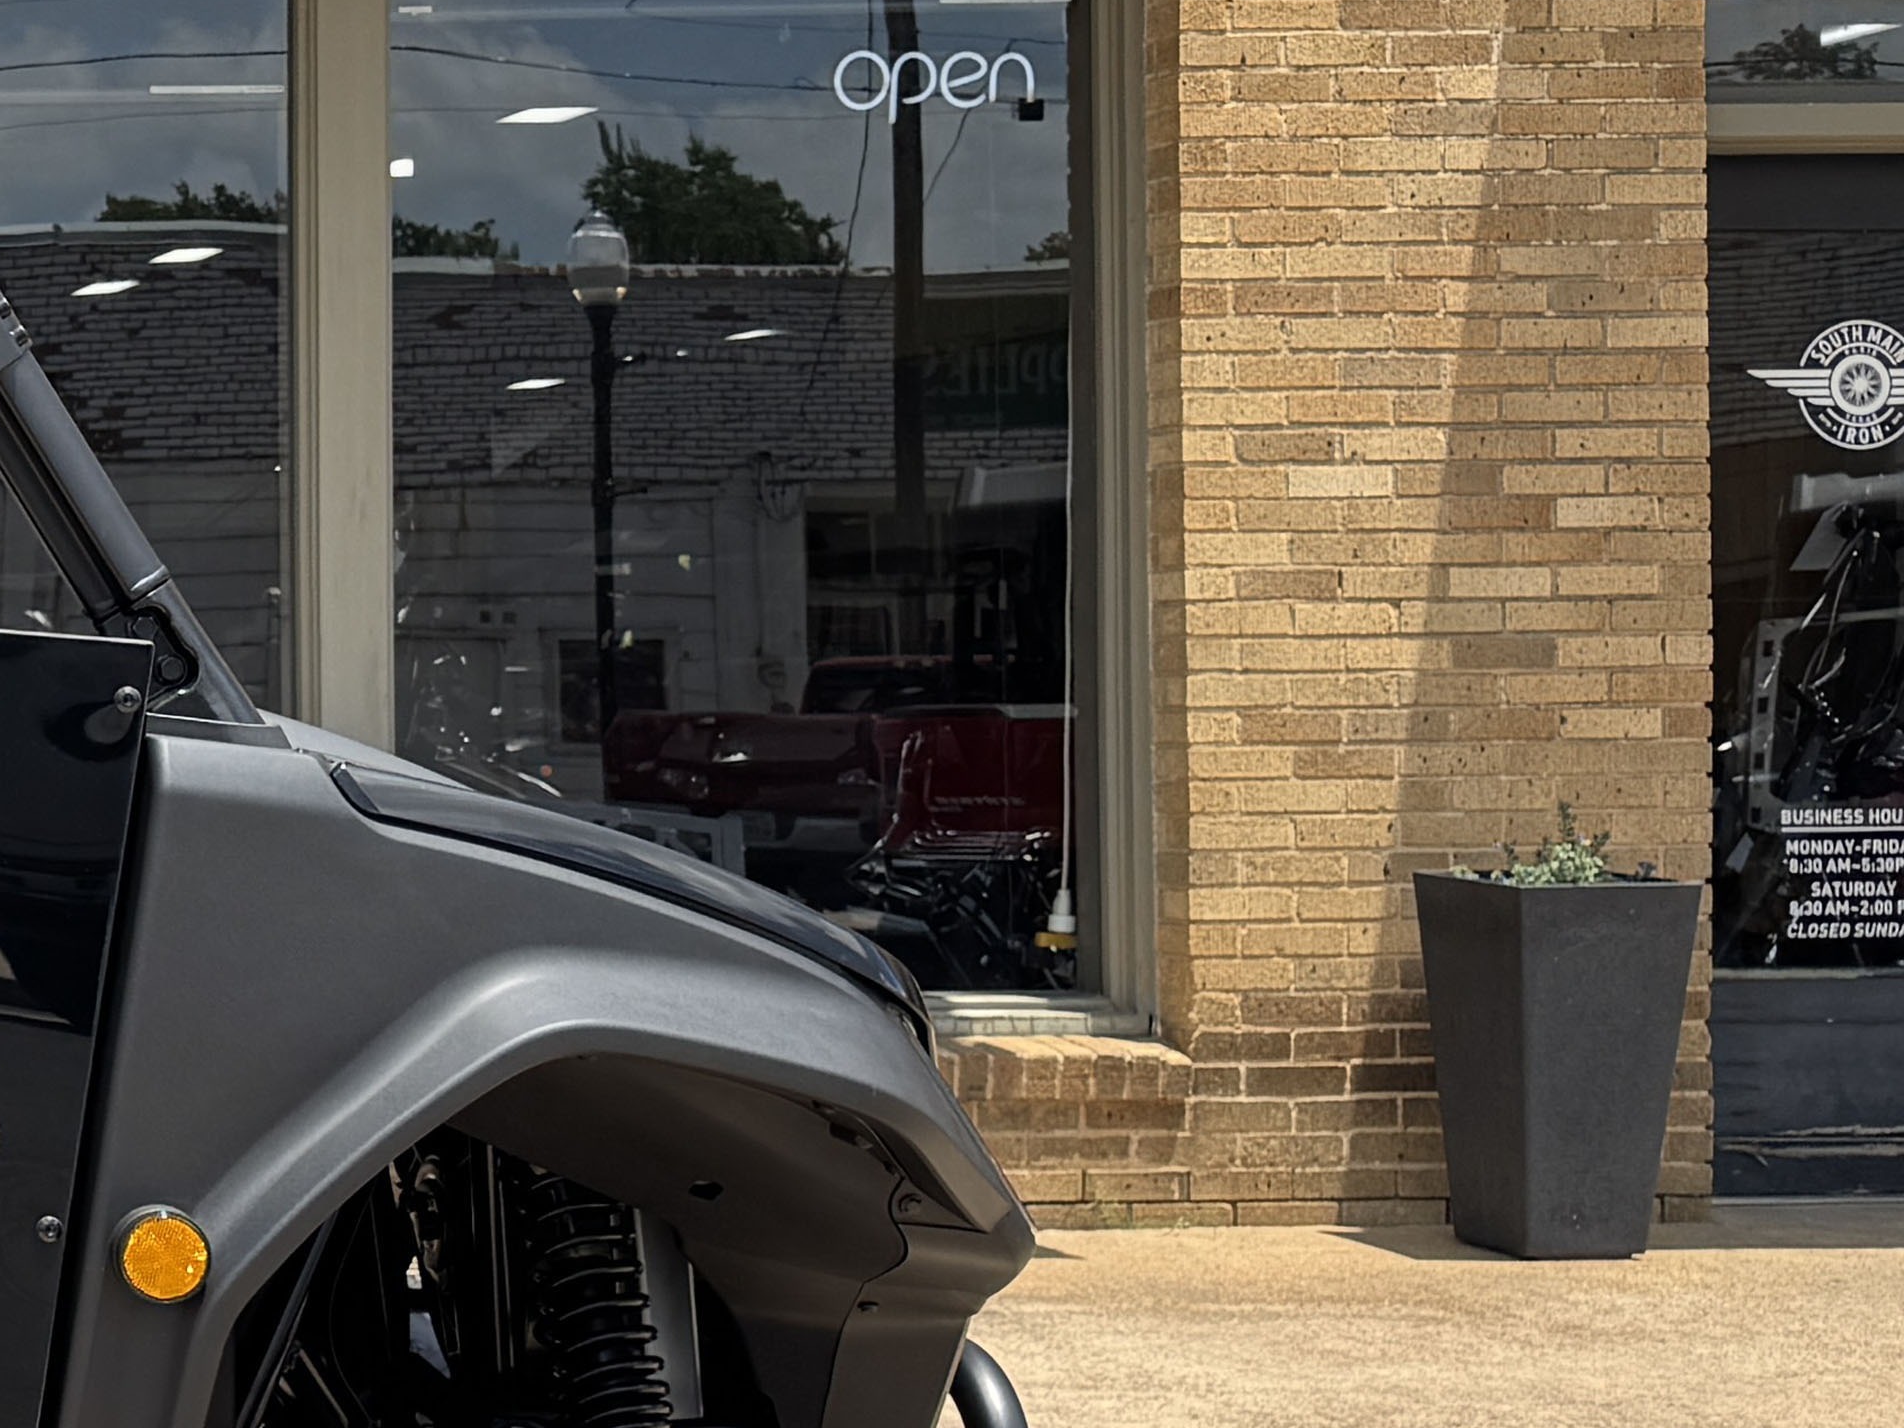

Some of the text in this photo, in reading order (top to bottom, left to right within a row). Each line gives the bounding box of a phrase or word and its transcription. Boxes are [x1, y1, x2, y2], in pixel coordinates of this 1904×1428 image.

[832, 49, 1036, 126] open
[1810, 325, 1862, 365] SOUTH
[1837, 424, 1884, 444] IRON
[1780, 808, 1864, 825] BUSINESS
[1810, 880, 1898, 897] SATURDAY
[1786, 922, 1851, 939] CLOSED
